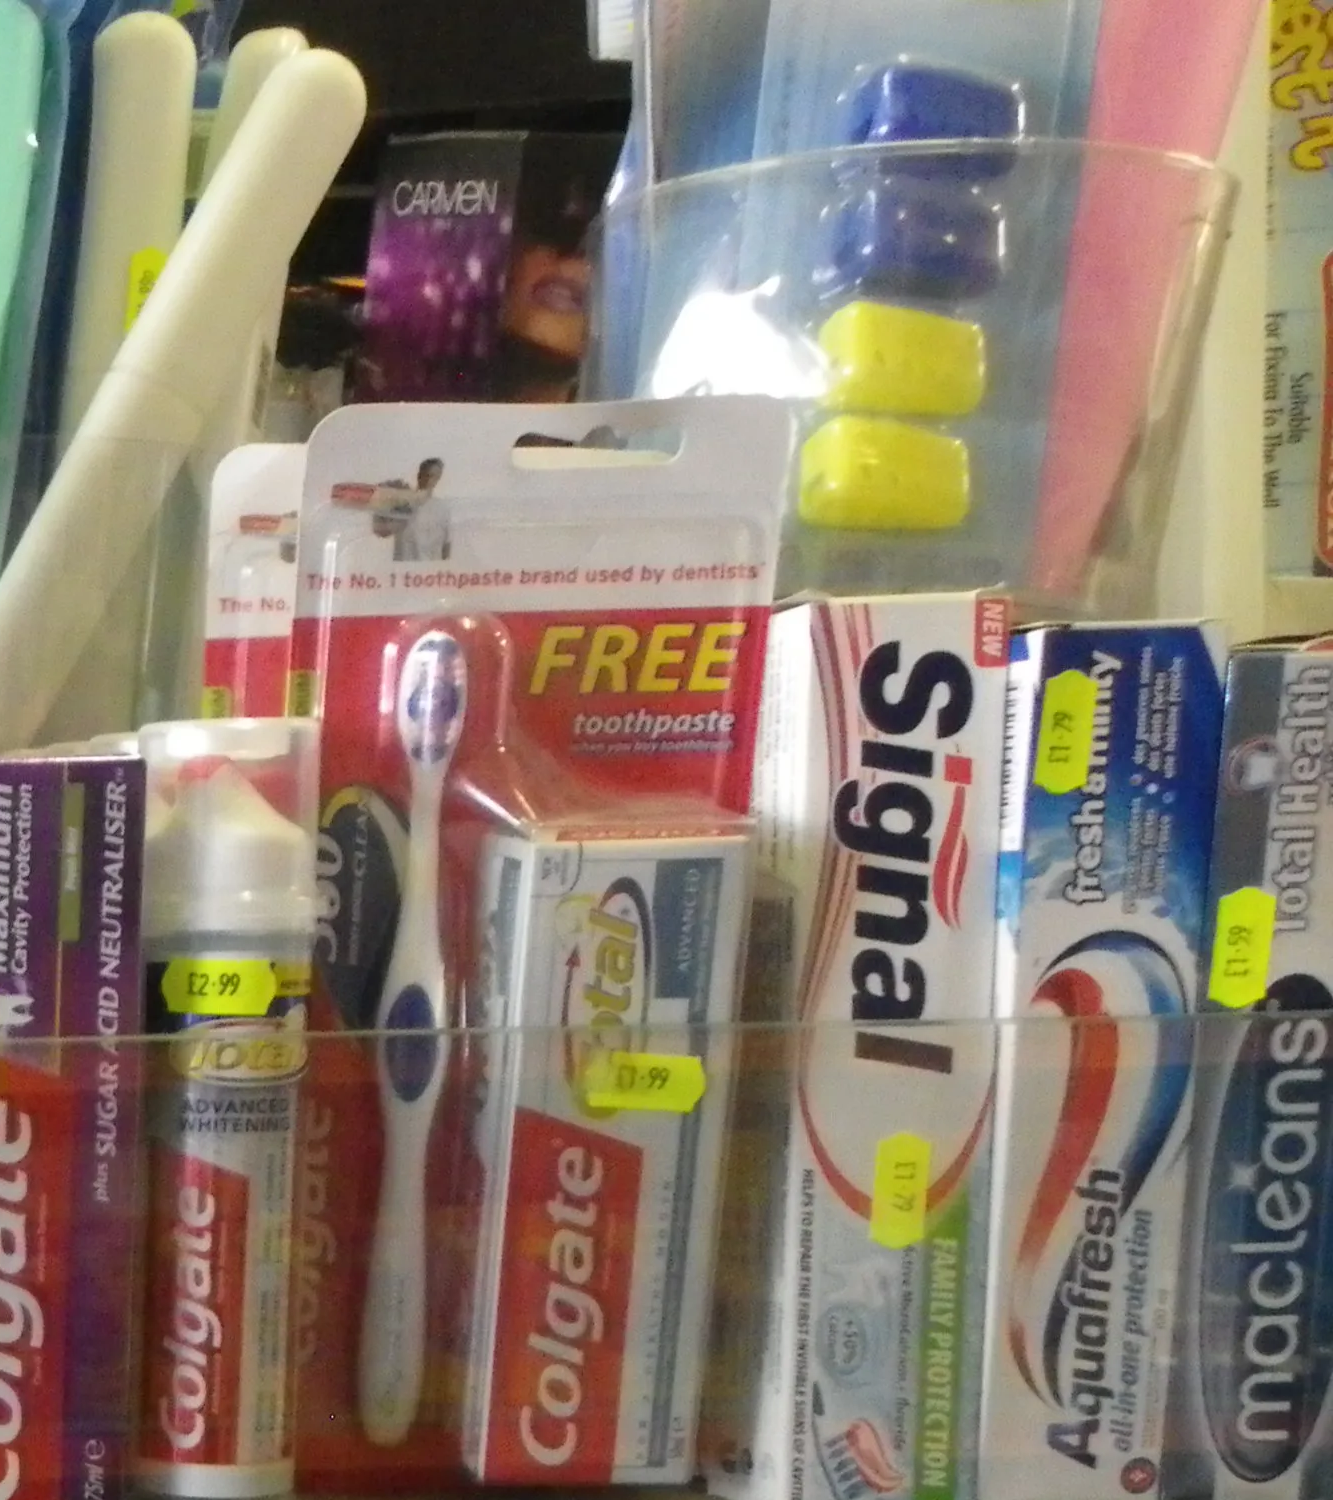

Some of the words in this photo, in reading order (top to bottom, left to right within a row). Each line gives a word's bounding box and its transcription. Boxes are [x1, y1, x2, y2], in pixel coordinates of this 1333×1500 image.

[392, 180, 497, 215] CARMEN
[306, 573, 341, 591] The
[350, 572, 383, 590] No.
[389, 573, 398, 589] 1
[403, 570, 513, 590] toothpaste
[519, 567, 577, 586] brand
[585, 566, 634, 583] used
[640, 565, 666, 584] by
[672, 563, 759, 583] dentists
[529, 621, 747, 696] FREE
[573, 708, 735, 739] toothpaste
[1277, 664, 1332, 817] Health
[12, 782, 34, 899] Protection
[100, 780, 126, 979] NEUTRALISER
[834, 640, 974, 1076] Signal
[12, 904, 33, 975] Cavity
[99, 984, 120, 1055] ACID
[97, 1061, 121, 1158] SUGAR
[178, 1116, 292, 1133] WHITENING
[180, 1098, 290, 1113] ADVANCED
[93, 1162, 114, 1203] plus
[1231, 1017, 1330, 1442] macleans
[520, 1142, 606, 1469] Colgate
[929, 1238, 959, 1330] FAMILY
[1047, 1168, 1123, 1469] Aquafresh
[921, 1332, 955, 1488] PROTECTION
